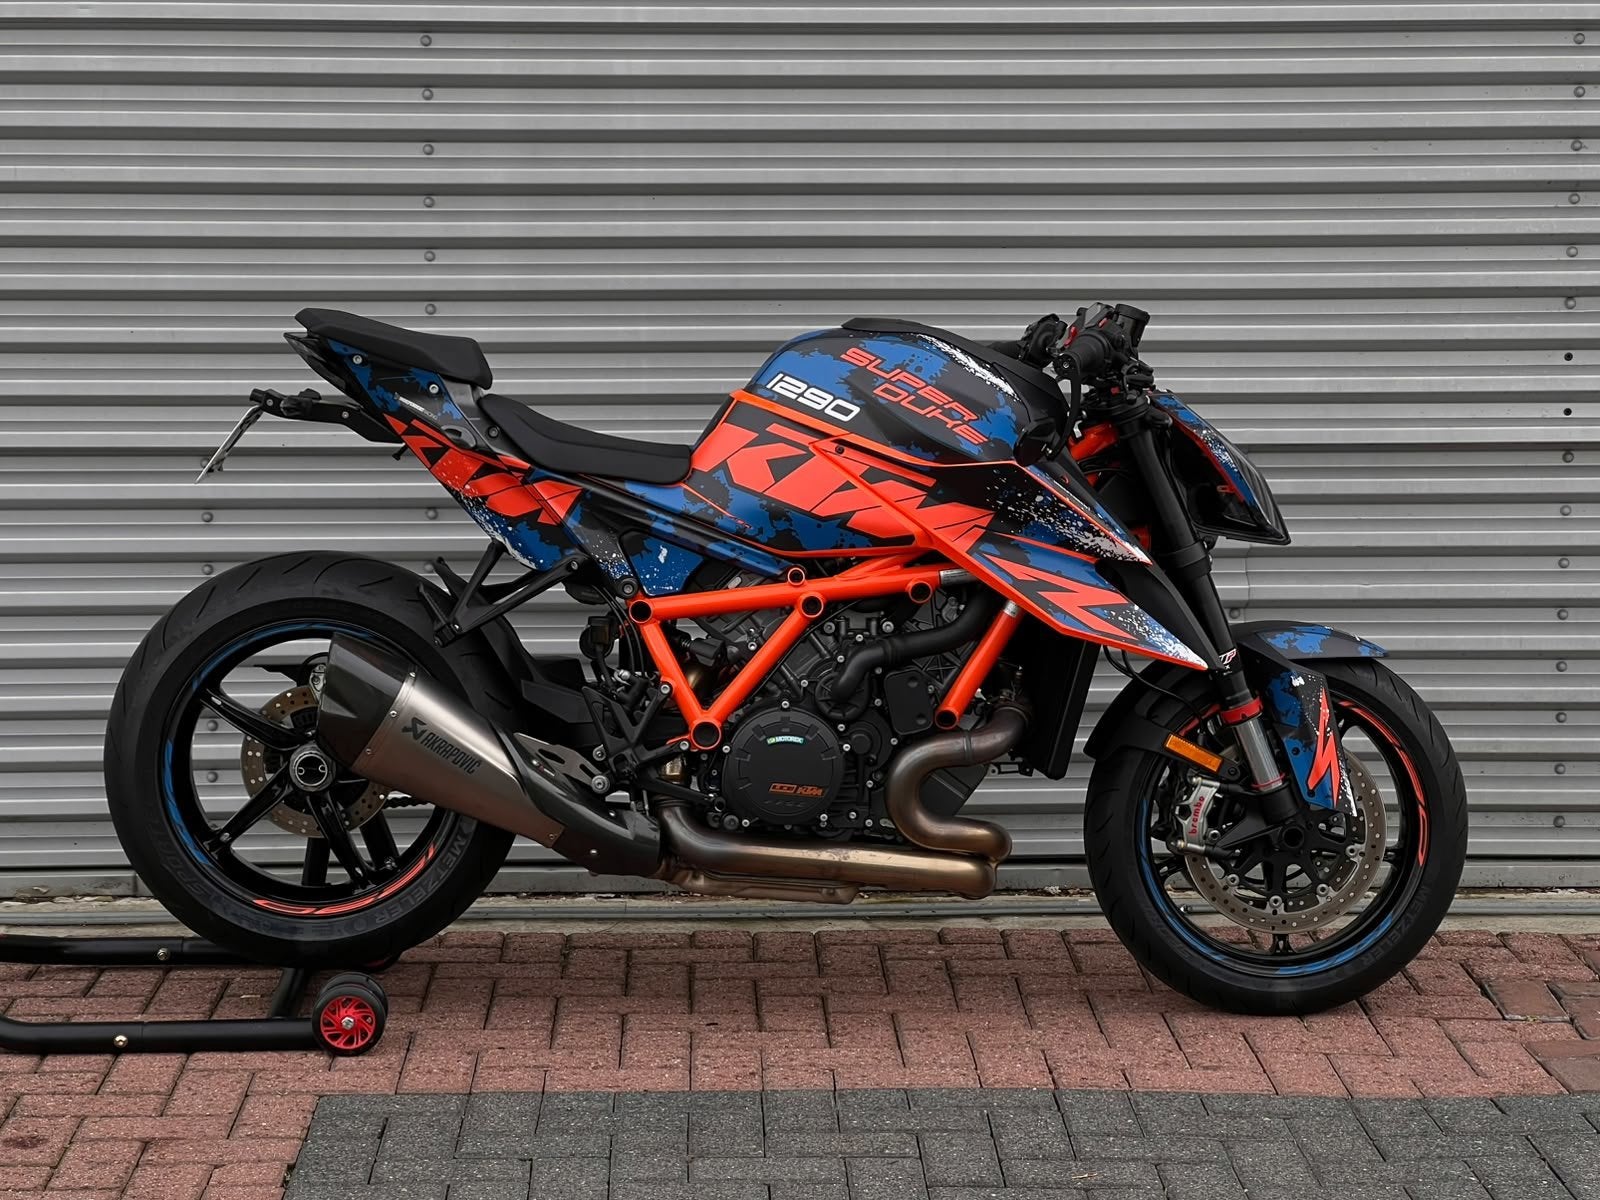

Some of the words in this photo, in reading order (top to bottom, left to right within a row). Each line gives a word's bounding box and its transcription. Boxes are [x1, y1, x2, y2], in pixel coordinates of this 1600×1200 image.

[765, 372, 861, 423] 1290
[840, 347, 979, 422] SUPER
[873, 383, 989, 446] DUKE
[691, 422, 996, 553] KTM
[1189, 795, 1205, 836] brembo
[373, 831, 471, 925] METZELER
